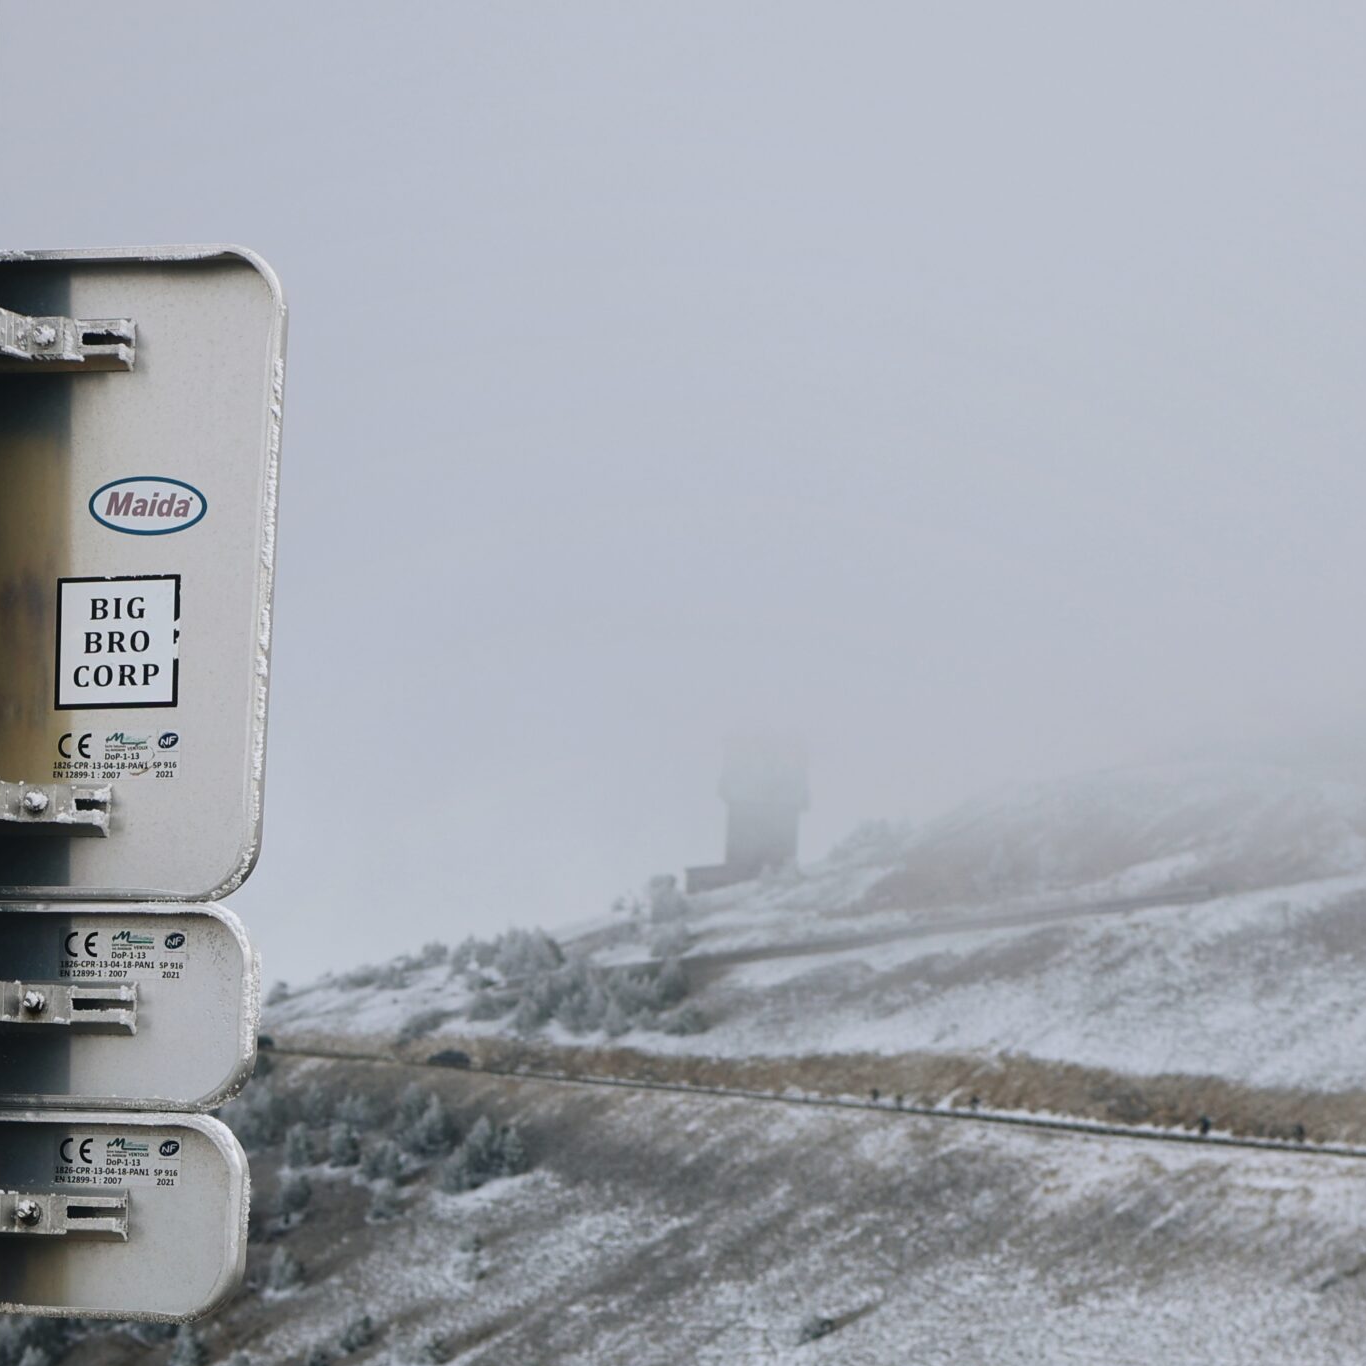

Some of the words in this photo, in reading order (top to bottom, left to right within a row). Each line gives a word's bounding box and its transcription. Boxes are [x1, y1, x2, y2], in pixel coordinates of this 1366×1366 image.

[105, 492, 191, 517] Maida
[90, 597, 145, 620] BIG
[83, 630, 150, 654] BRO
[73, 663, 160, 687] CORP
[163, 761, 177, 769] 916
[101, 771, 121, 779] 2007
[162, 971, 180, 979] 2021
[164, 1169, 178, 1177] 916
[67, 1176, 97, 1184] 12899-1
[156, 1178, 175, 1186] 2021
